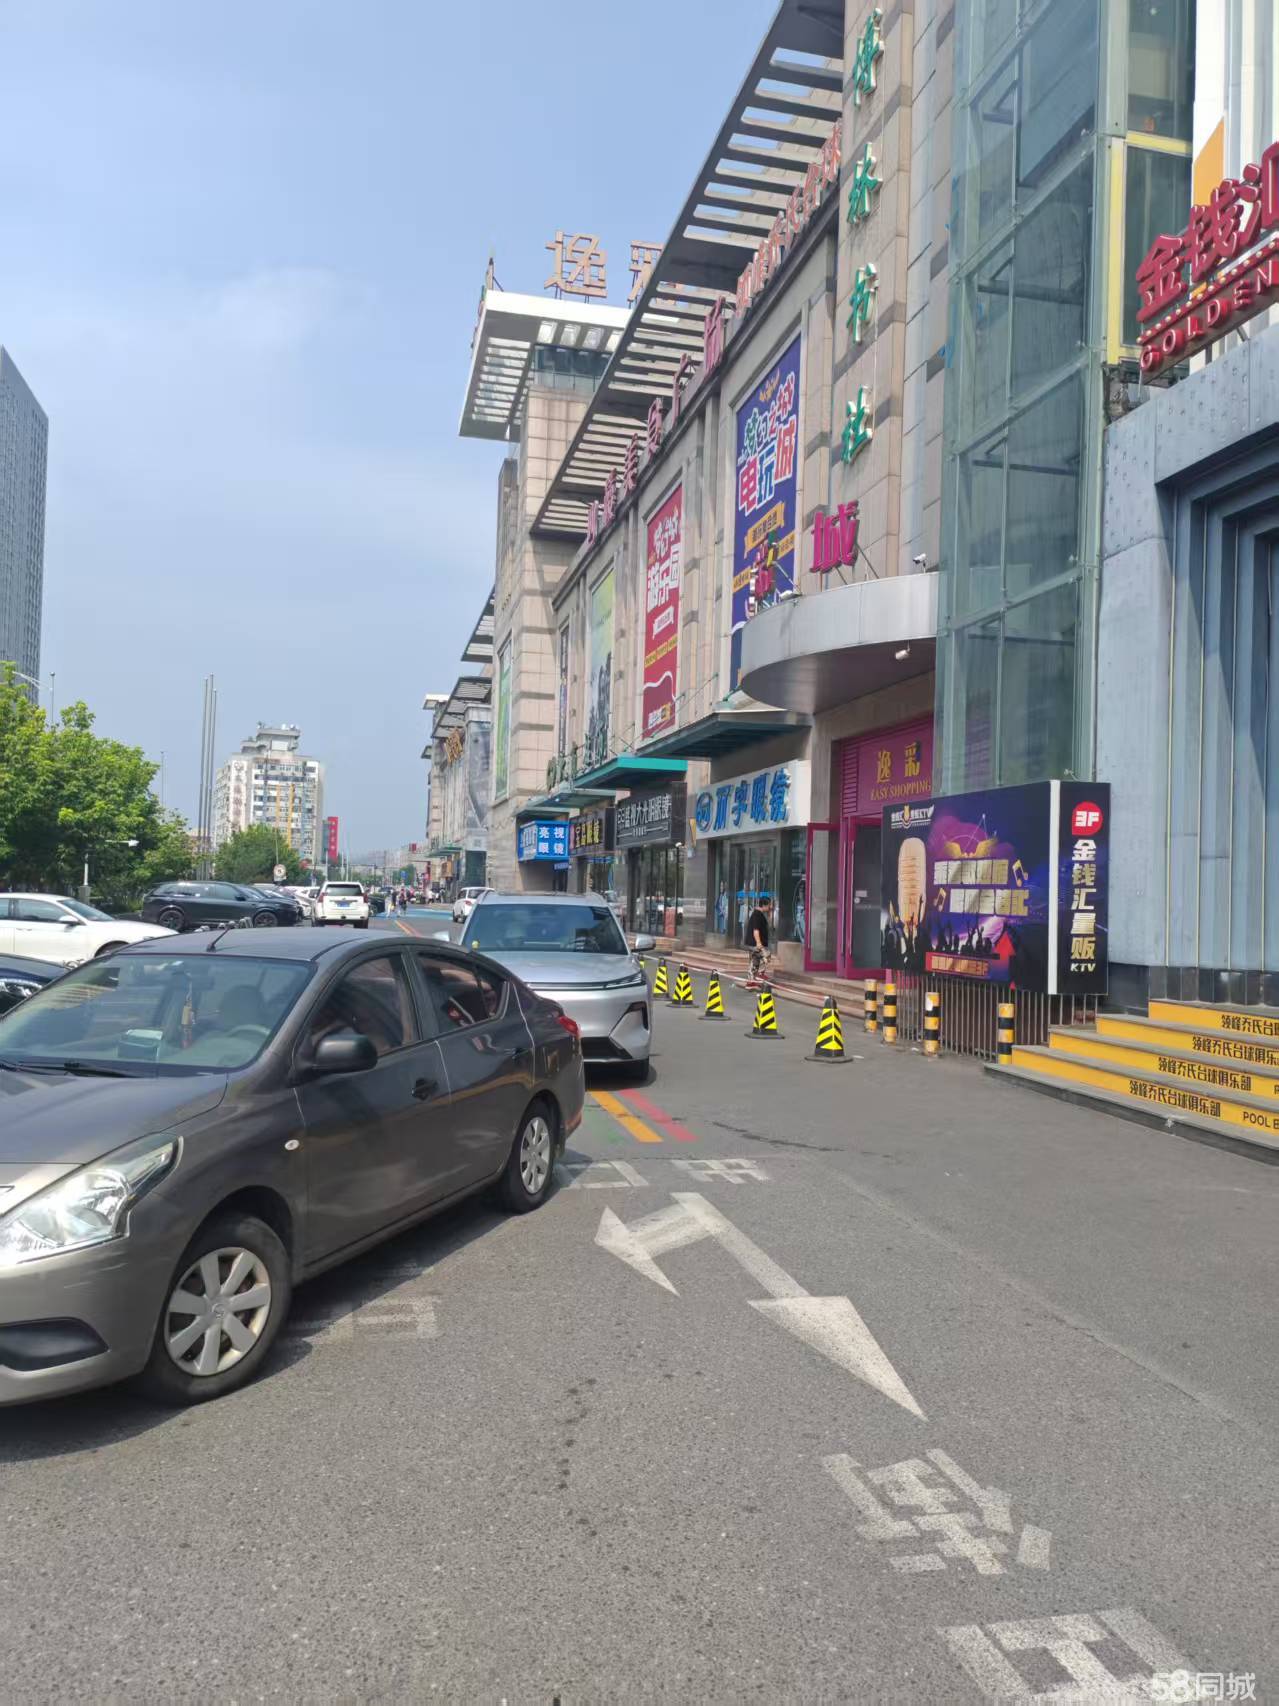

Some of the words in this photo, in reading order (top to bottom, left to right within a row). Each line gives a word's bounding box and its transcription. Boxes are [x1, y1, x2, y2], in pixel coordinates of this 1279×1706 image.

[1136, 141, 1279, 323] 金钱汇
[1140, 259, 1278, 373] GOLDEN
[738, 415, 797, 517] 电玩城
[647, 542, 681, 612] 游乐园
[876, 741, 921, 784] 逸彩
[871, 784, 889, 801] EASY
[890, 778, 932, 798] SHOPPING
[538, 825, 565, 840] 亮视
[538, 841, 565, 855] 眼镜
[1071, 839, 1097, 960] 金钱汇量贩
[1070, 962, 1096, 972] KTV
[1192, 1036, 1279, 1067] 领峰乔氏台球俱乐
[1158, 1056, 1252, 1092] 领峰乔氏台球俱乐部
[1129, 1079, 1221, 1118] 领峰乔氏台球俱乐部
[1243, 1110, 1271, 1129] POOL
